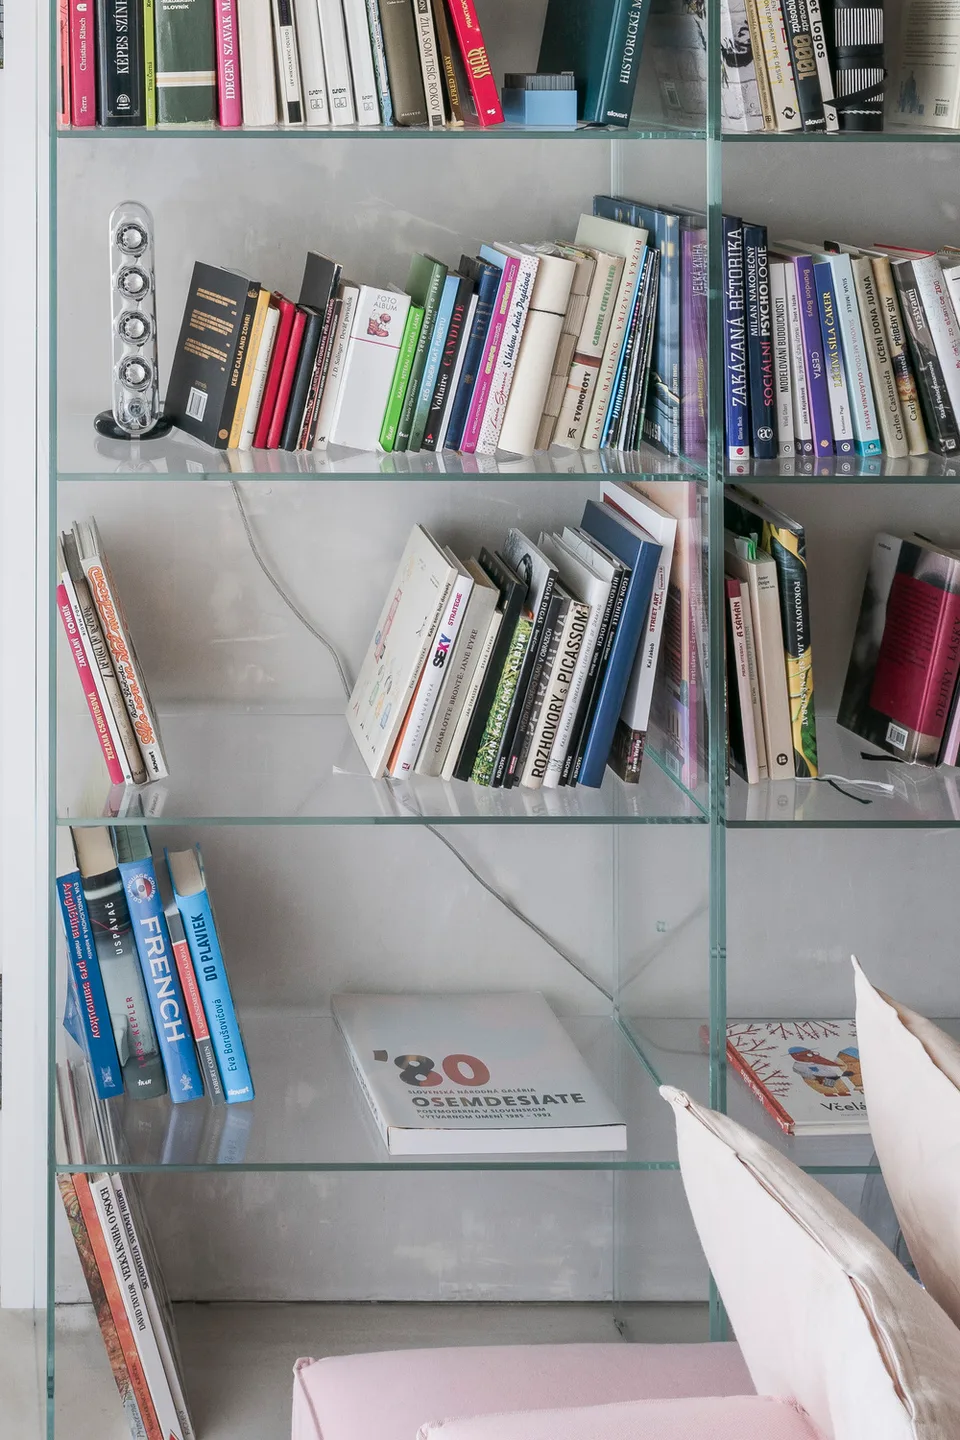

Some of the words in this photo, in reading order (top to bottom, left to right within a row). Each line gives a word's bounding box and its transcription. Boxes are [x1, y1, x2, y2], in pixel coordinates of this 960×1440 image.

[76, 3, 87, 12] A
[79, 17, 87, 36] Rätsch
[222, 15, 233, 56] SZAVAK
[420, 17, 430, 37] ŽILA
[812, 20, 826, 59] logos
[116, 35, 129, 75] KÉPES
[422, 37, 432, 57] SOM
[618, 10, 641, 85] HISTORICKÉ
[792, 33, 818, 81] 1000
[225, 59, 236, 99] IDEGEN
[443, 55, 455, 75] JARRY
[428, 82, 440, 111] ROKOV
[449, 75, 460, 106] ALFRED
[722, 228, 744, 310] RÉTORIKA
[746, 246, 756, 301] NAKONEČNÝ
[801, 268, 813, 298] Brandon
[376, 294, 397, 305] FOTO
[756, 245, 770, 335] PSYCHOLOGIE
[841, 277, 849, 293] SILVA
[862, 275, 875, 306] JUANA
[374, 301, 398, 311] ALBUM
[592, 310, 606, 347] GABRIEL
[600, 264, 617, 313] CHEVALLIER
[805, 300, 815, 317] Bays
[821, 291, 834, 325] ČAKER
[885, 295, 895, 312] SÍLY
[905, 289, 924, 331] vrstvami
[242, 314, 251, 334] ZOMRI
[749, 304, 758, 335] MILAN
[774, 297, 785, 345] BUDOUCNOSTI
[869, 307, 882, 334] DONA
[888, 313, 902, 346] PŘÍBĚHY
[239, 331, 247, 348] AND
[503, 333, 517, 360] láskou
[826, 327, 837, 349] SÍLA
[873, 336, 887, 363] UČENÍ
[235, 347, 244, 368] CALM
[431, 373, 449, 411] Voltaire
[442, 303, 465, 367] CANDIDE
[727, 316, 747, 406] ZAKÁZANÁ
[775, 347, 788, 392] MODELOVÁNÍ
[828, 351, 842, 387] LÉČIVÁ
[895, 350, 914, 393] Castaneda
[230, 368, 240, 387] KEEP
[759, 341, 773, 405] SOCIÁLNÍ
[573, 370, 592, 423] ZVONOKOSY
[590, 397, 606, 439] DANIEL
[603, 341, 619, 392] MAJLING
[883, 369, 897, 412] Castaneda
[904, 393, 920, 421] Carlos
[891, 413, 903, 440] Carlos
[542, 576, 554, 600] EDGAR
[619, 576, 630, 594] EGON
[651, 592, 660, 606] ART
[536, 601, 548, 624] DEGAS
[602, 576, 620, 627] HIERONYMUS
[611, 597, 625, 625] SCHIELE
[792, 580, 804, 639] POKOJOVKY
[427, 624, 436, 637] Keby
[430, 633, 453, 669] SEXY
[445, 592, 463, 626] STRATEGIE
[646, 606, 660, 632] STREET
[539, 627, 552, 657] OBRAZECH
[595, 622, 607, 646] BOSCH
[796, 642, 805, 658] JAK
[434, 706, 453, 753] CHARLOTTE
[459, 650, 471, 671] JANE
[466, 628, 478, 650] EYRE
[483, 739, 497, 762] JAN
[507, 632, 527, 672] ALBUM
[529, 693, 565, 778] ROZHOVORY
[556, 609, 589, 684] PICASSOM
[86, 691, 106, 733] CSONTOSOVÁ
[100, 733, 115, 760] ZUZANA
[562, 755, 572, 777] TASCHEN
[572, 756, 583, 778] TASCHEN
[62, 881, 82, 938] Angličtina
[104, 901, 124, 955] USPÁVAČ
[197, 912, 213, 957] PLAVIEK
[73, 939, 83, 959] nielen
[76, 959, 89, 980] pre
[139, 914, 187, 1044] FRENCH
[202, 964, 218, 982] DO
[80, 980, 101, 1040] samoukov
[125, 995, 141, 1037] KEPLER
[213, 998, 236, 1054] Borušovičová
[202, 1045, 215, 1069] COHEN
[225, 1056, 237, 1071] Eva
[207, 1067, 222, 1094] ROBERT
[411, 1093, 586, 1107] OSEMDESIATE
[98, 1186, 115, 1215] PSOCH
[107, 1215, 117, 1223] O
[108, 1223, 125, 1252] KNIHA
[115, 1250, 133, 1281] VEĽKÁ
[126, 1282, 141, 1310] TAYLOR
[133, 1308, 146, 1330] DAVID
